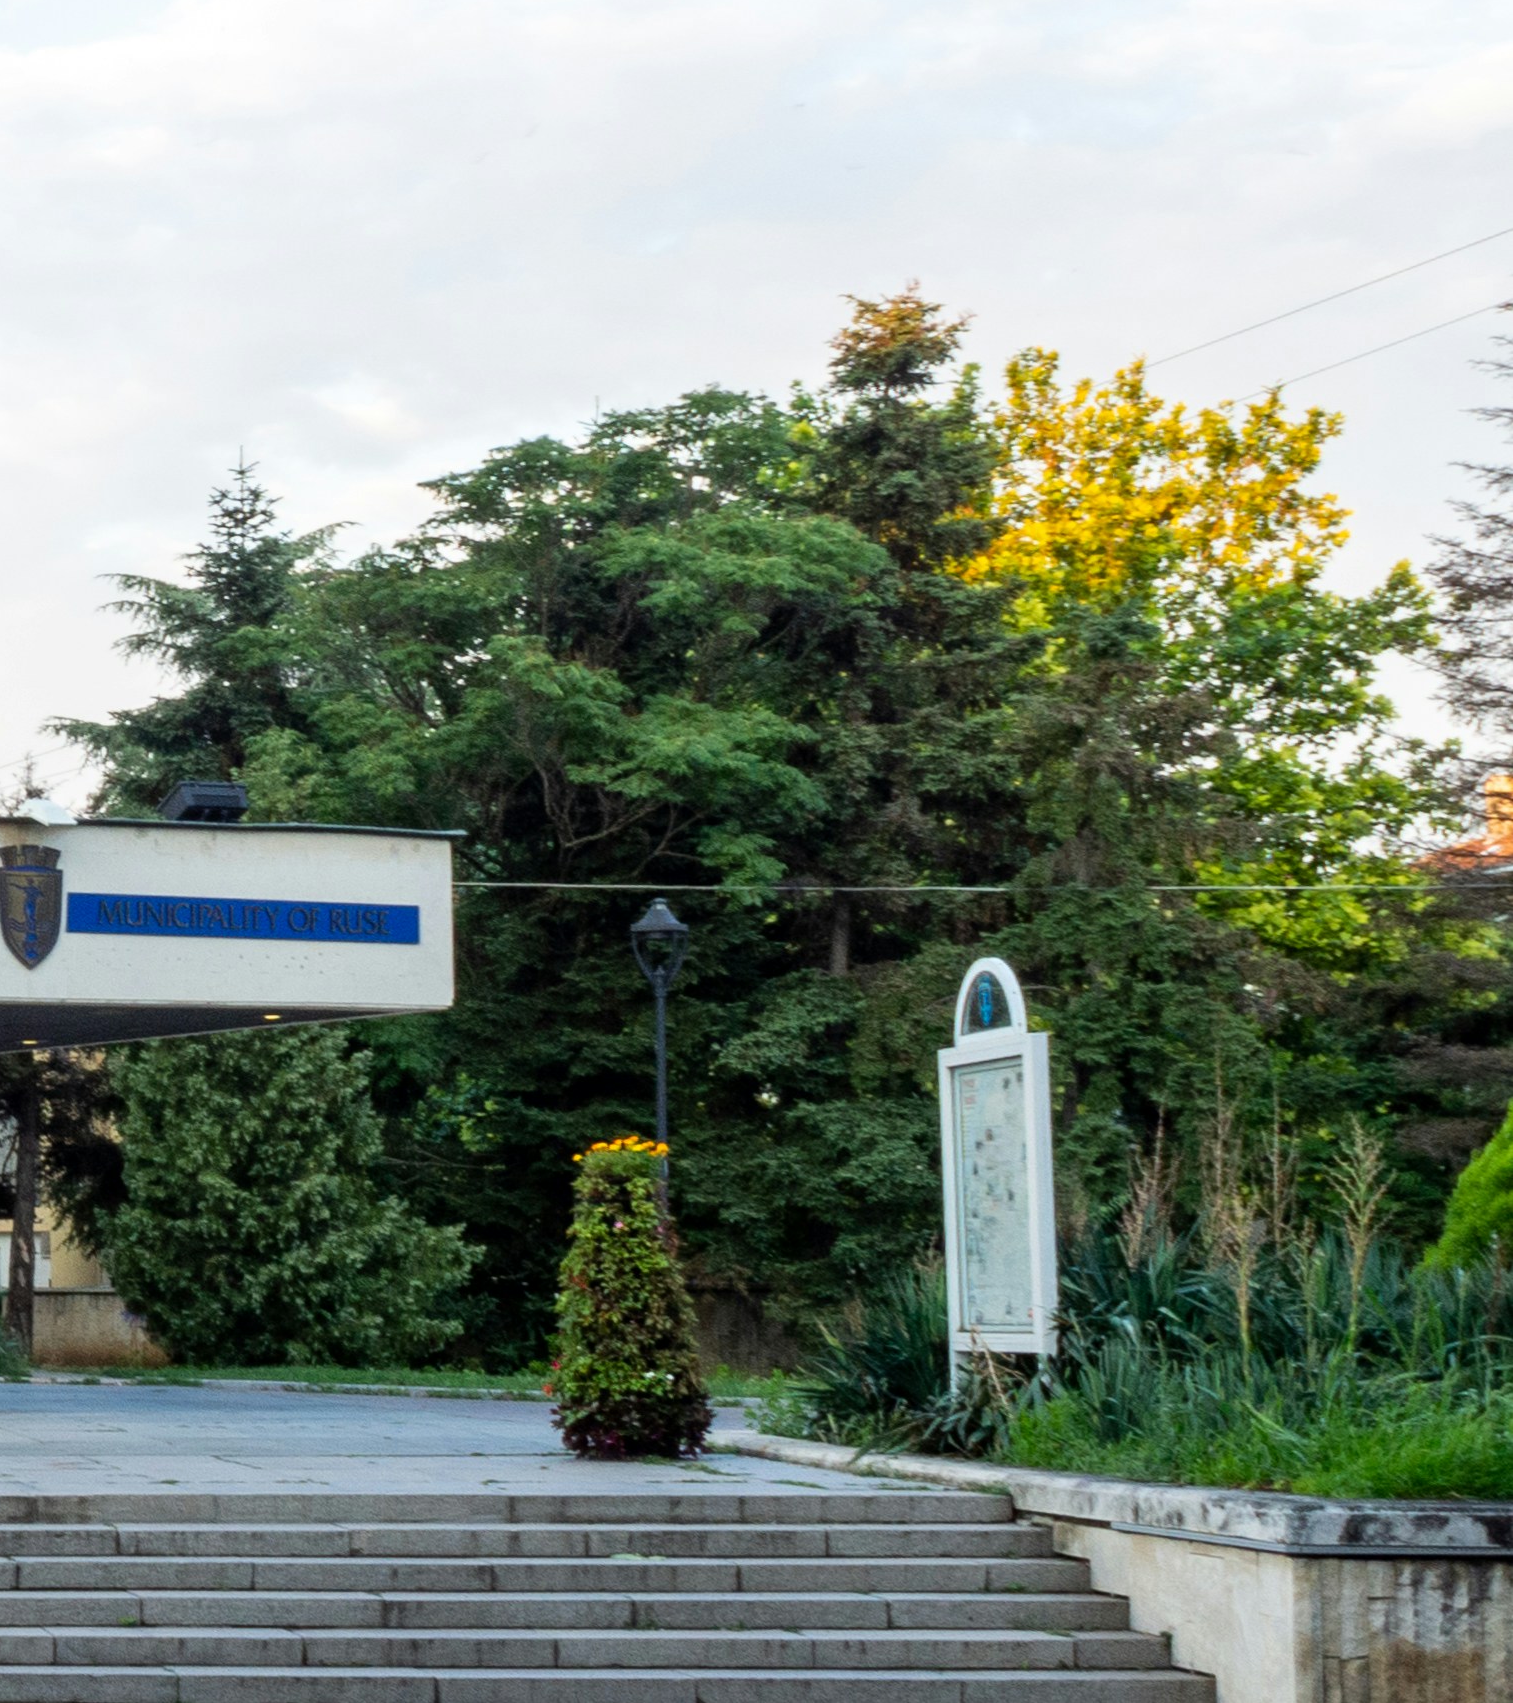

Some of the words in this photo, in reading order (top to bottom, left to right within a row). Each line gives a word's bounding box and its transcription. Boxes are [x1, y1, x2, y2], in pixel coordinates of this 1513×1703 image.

[97, 899, 280, 931] MUNICIPALITY
[287, 906, 320, 932] OF
[329, 908, 391, 935] RUSE
